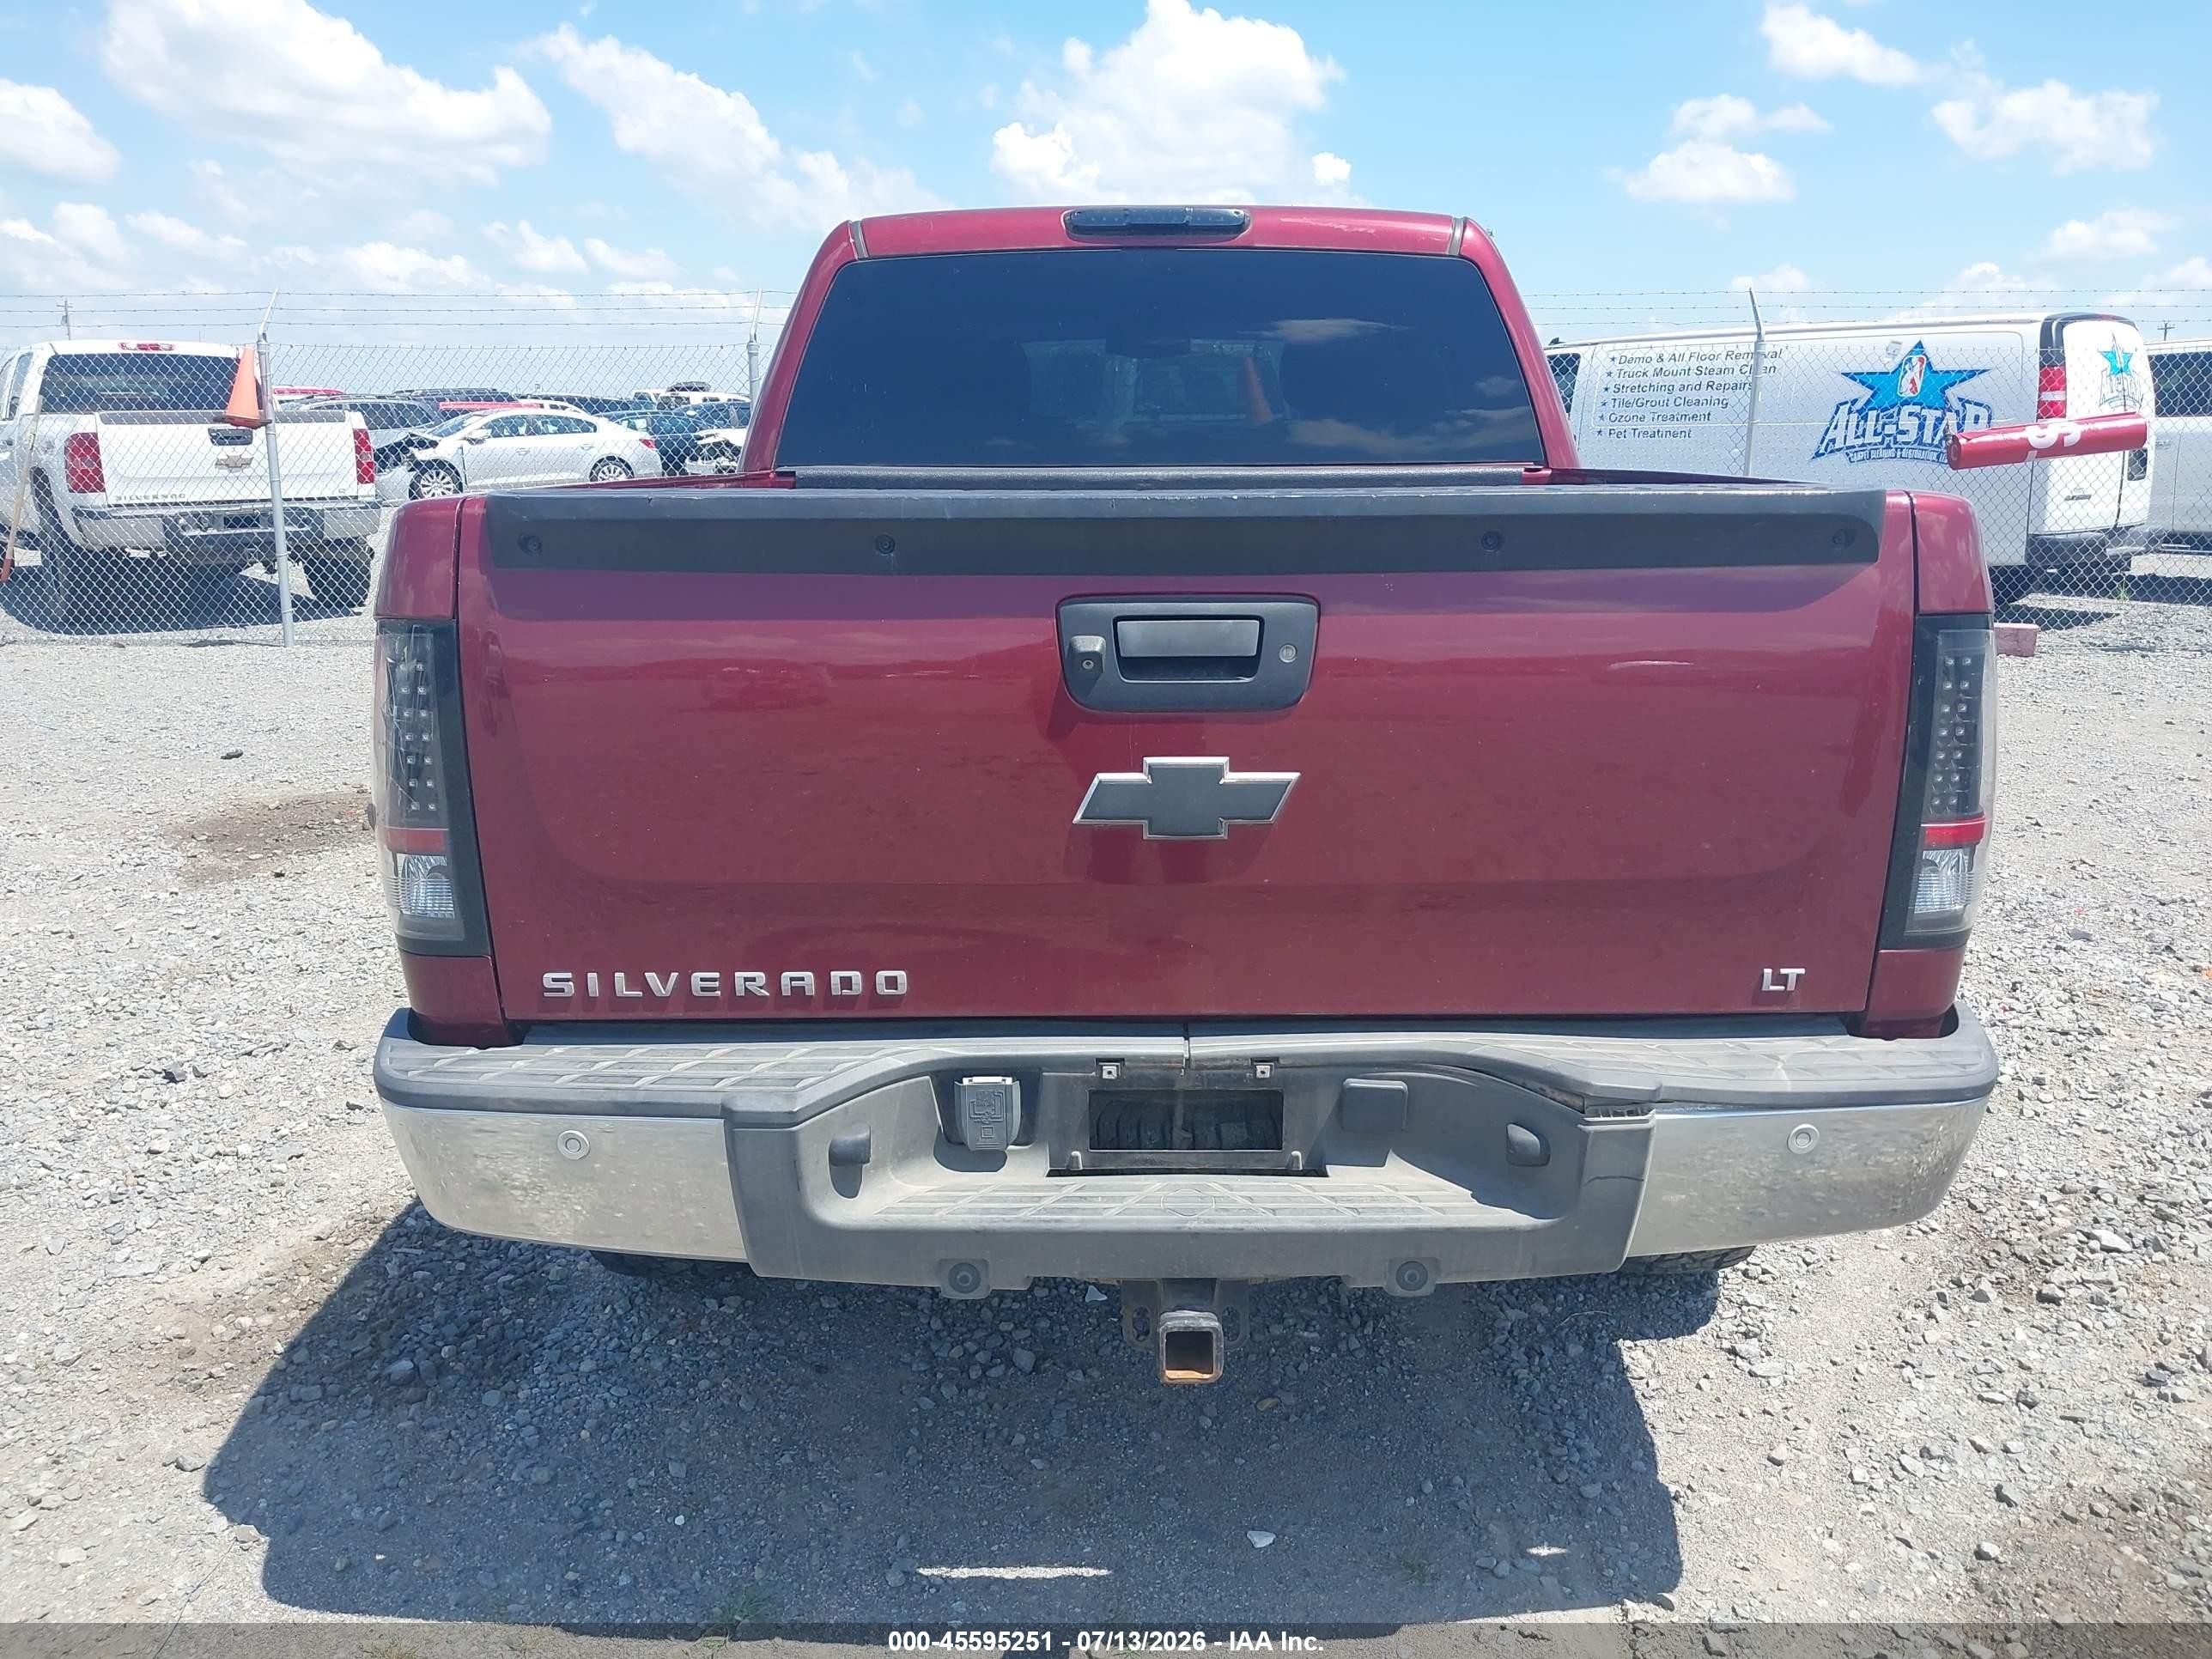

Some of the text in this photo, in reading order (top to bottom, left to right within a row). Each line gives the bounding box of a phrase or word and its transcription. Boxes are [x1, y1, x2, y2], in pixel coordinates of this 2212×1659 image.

[1619, 349, 1783, 365] Demo & All Floor Remval
[1616, 363, 1777, 379] Truck Mount Steam Clan
[1613, 382, 1675, 394] Stretching
[1679, 381, 1702, 392] and
[1611, 395, 1729, 409] Tile/Grout Cleaning
[1608, 411, 1711, 422] Ozone Treatment
[1608, 428, 1692, 439] Pet Treatment
[543, 970, 908, 998] SILVERADO
[1761, 968, 1806, 991] LT
